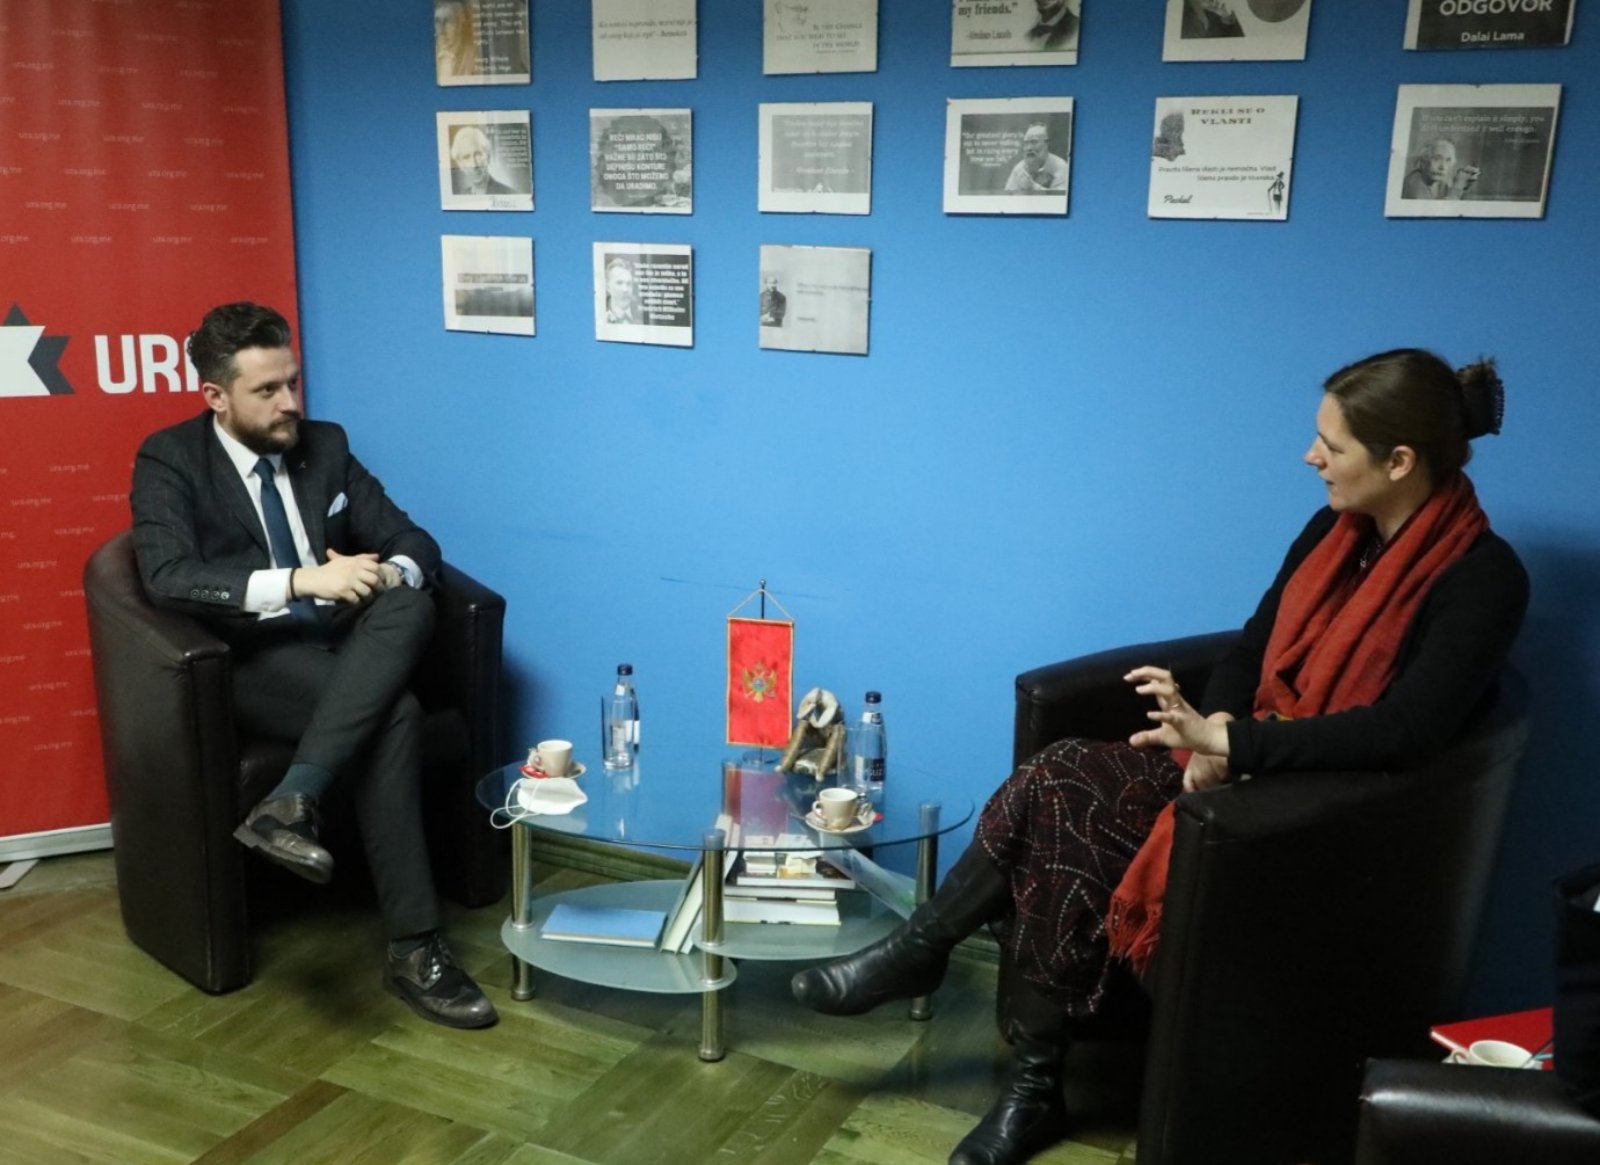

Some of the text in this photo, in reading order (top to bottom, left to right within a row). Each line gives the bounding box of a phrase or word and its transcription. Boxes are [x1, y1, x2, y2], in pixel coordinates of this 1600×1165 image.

[1439, 0, 1552, 16] ODGOVOR
[1460, 30, 1525, 42] Dalai Lama
